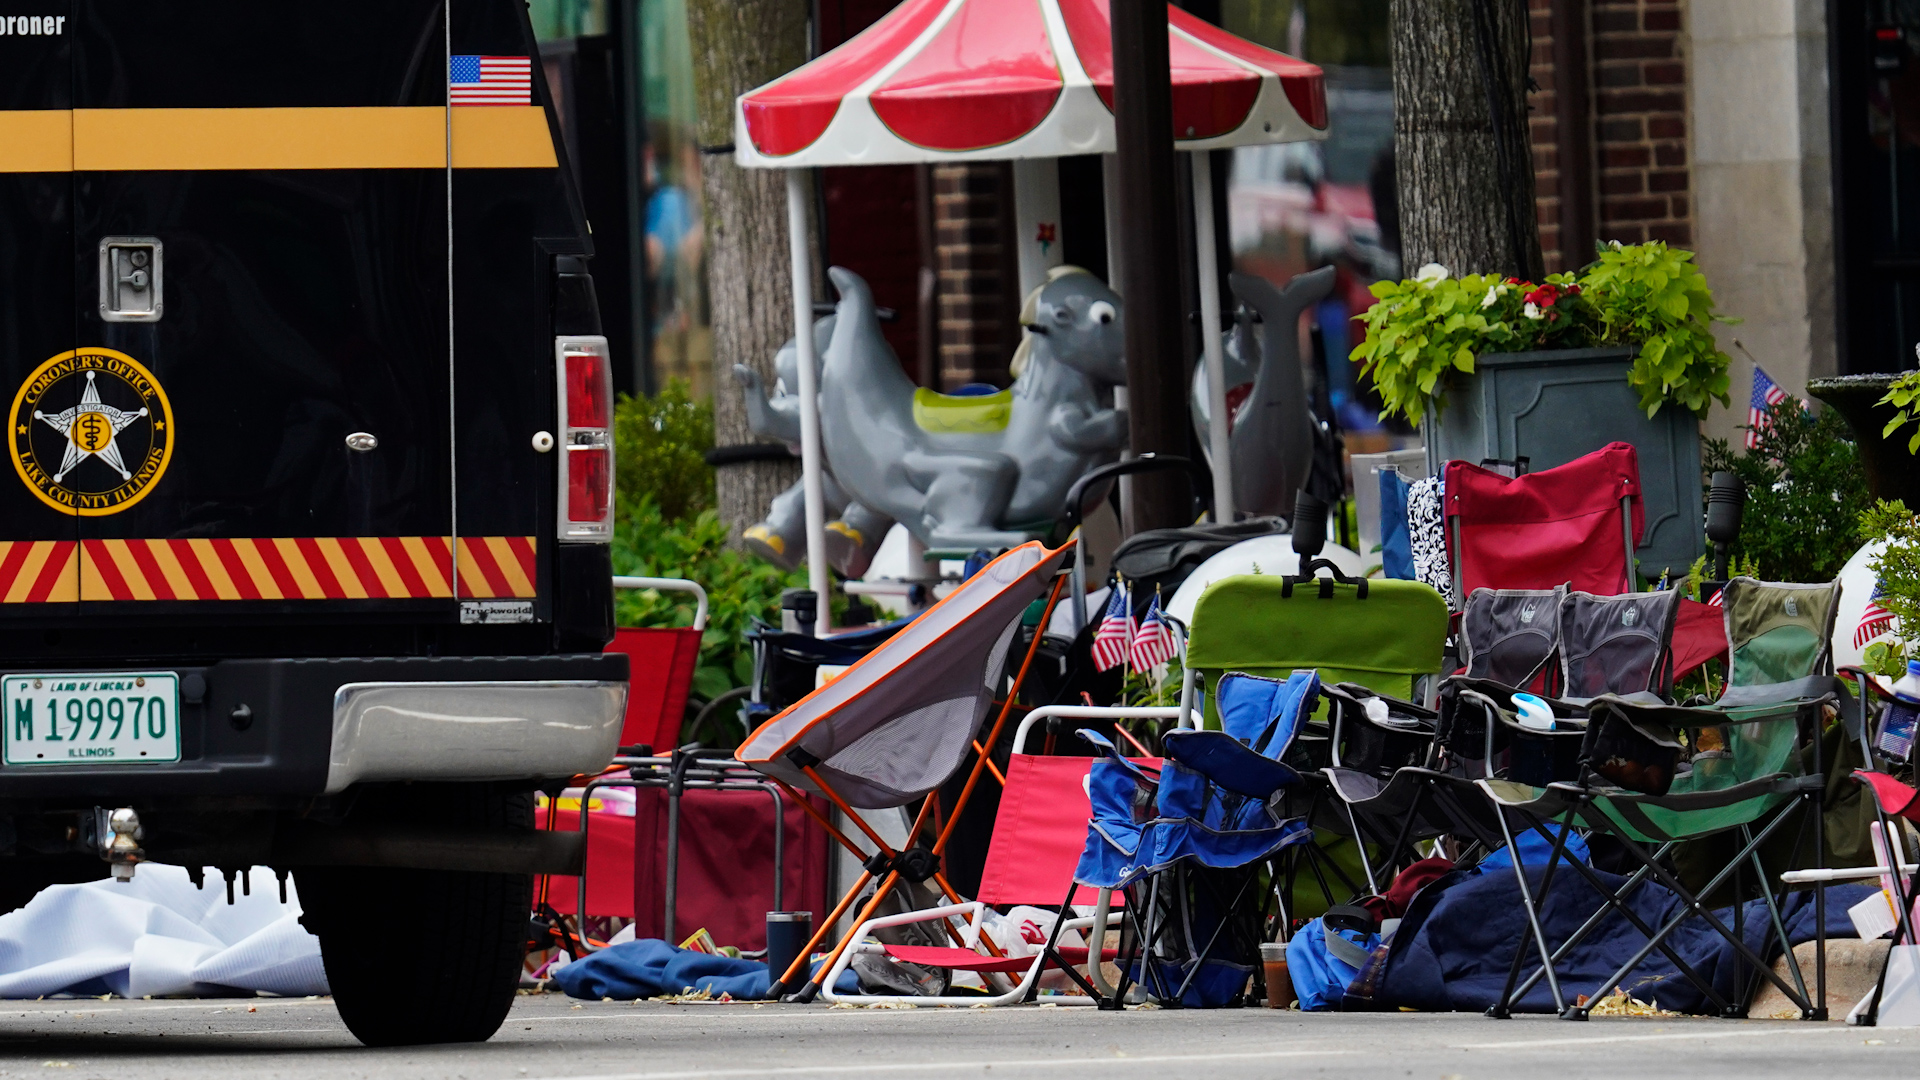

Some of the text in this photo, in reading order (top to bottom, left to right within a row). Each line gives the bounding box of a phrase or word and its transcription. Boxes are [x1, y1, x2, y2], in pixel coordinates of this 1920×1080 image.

[25, 356, 156, 404] CORONER'S OFFICE
[61, 404, 120, 419] INVESTIGATOR
[20, 447, 164, 508] LAKE COUNTY ILLINOIS
[20, 683, 28, 692] P
[50, 681, 134, 692] LAND OF LINCOLN
[15, 696, 166, 741] M 199970
[68, 748, 115, 757] ILLINOIS
